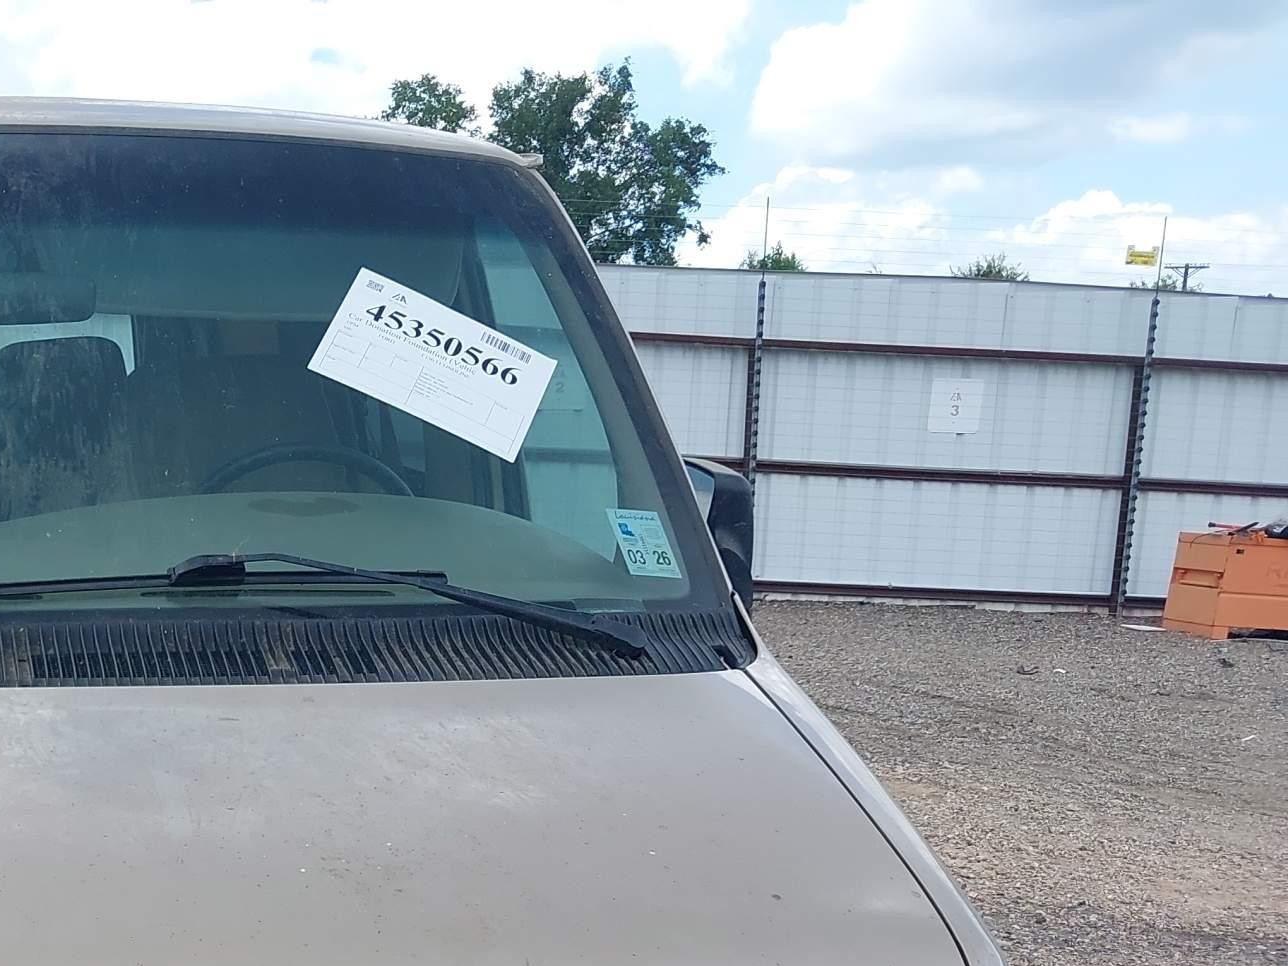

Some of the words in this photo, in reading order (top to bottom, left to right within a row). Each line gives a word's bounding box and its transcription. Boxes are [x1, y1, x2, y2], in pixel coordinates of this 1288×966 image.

[366, 304, 521, 385] 45350566
[950, 404, 960, 417] 3
[627, 549, 647, 565] 03
[652, 550, 672, 566] 26
